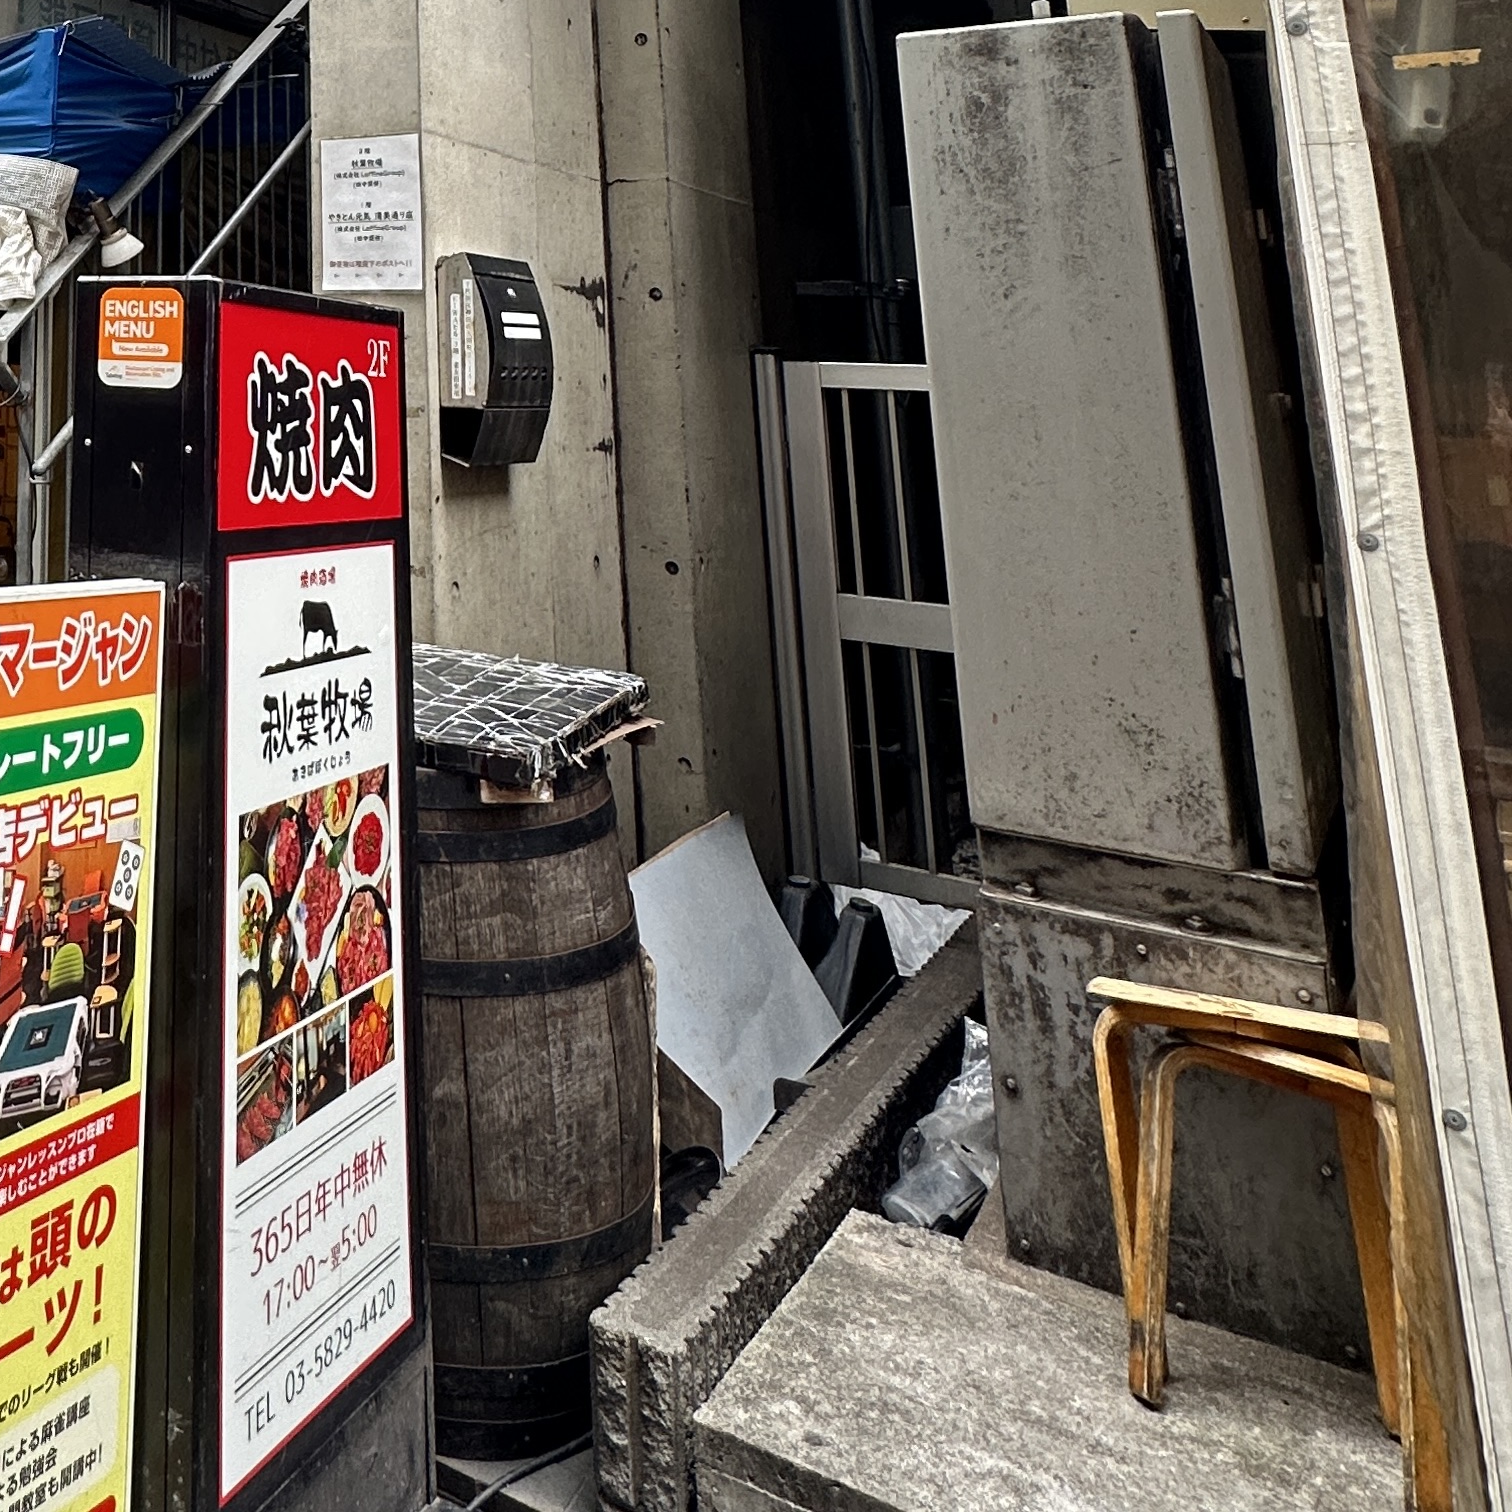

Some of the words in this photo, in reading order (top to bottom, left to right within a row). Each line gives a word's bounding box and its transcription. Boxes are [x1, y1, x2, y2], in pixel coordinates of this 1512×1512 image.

[104, 299, 179, 319] ENGLISH
[104, 319, 155, 339] MENU
[366, 339, 392, 379] 2F
[248, 351, 376, 504] 焼肉
[259, 676, 374, 764] 秋葉牧場
[249, 1135, 389, 1278] 365日年中無休
[243, 1390, 276, 1443] TEL
[284, 1278, 397, 1405] 03-5829-4420
